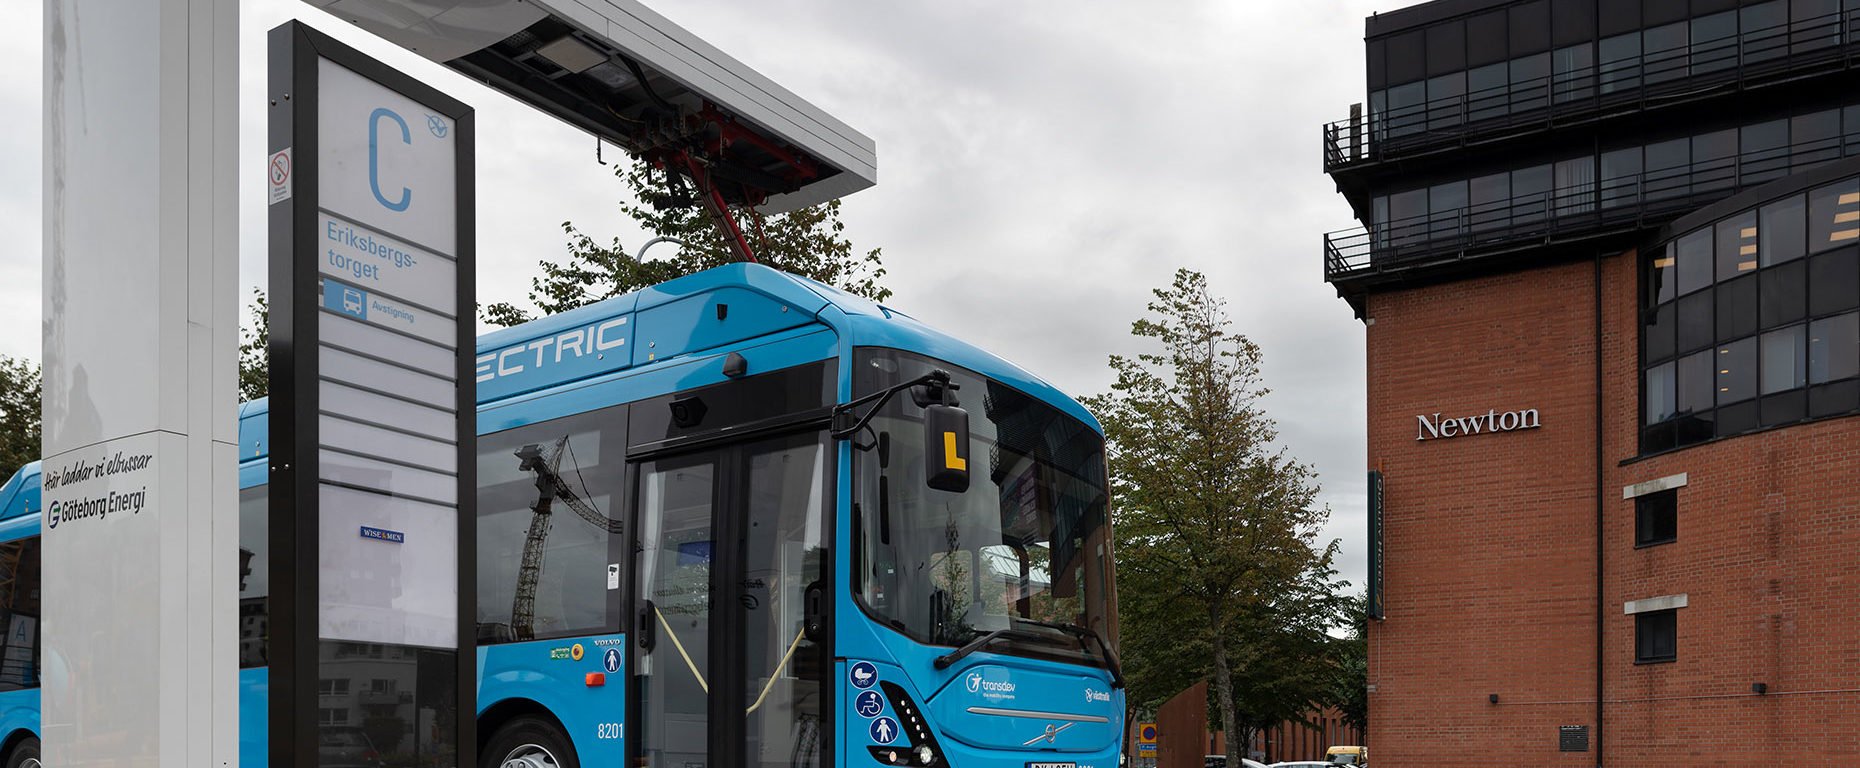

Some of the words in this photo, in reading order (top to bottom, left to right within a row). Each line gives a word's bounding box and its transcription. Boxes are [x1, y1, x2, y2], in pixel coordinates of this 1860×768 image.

[368, 107, 412, 212] C
[327, 220, 417, 268] Eriksbergs-
[327, 249, 379, 280] torget
[372, 300, 415, 323] Avstigning
[1416, 408, 1542, 440] Newton
[943, 431, 966, 471] L
[44, 470, 61, 491] Här
[61, 459, 94, 486] laddar
[95, 456, 106, 478] vi
[107, 451, 153, 475] elbussar
[62, 496, 107, 522] Göteborg
[108, 486, 146, 514] Energi
[594, 638, 621, 646] VOLVO
[982, 680, 1016, 692] transdev
[598, 722, 623, 739] 8201
